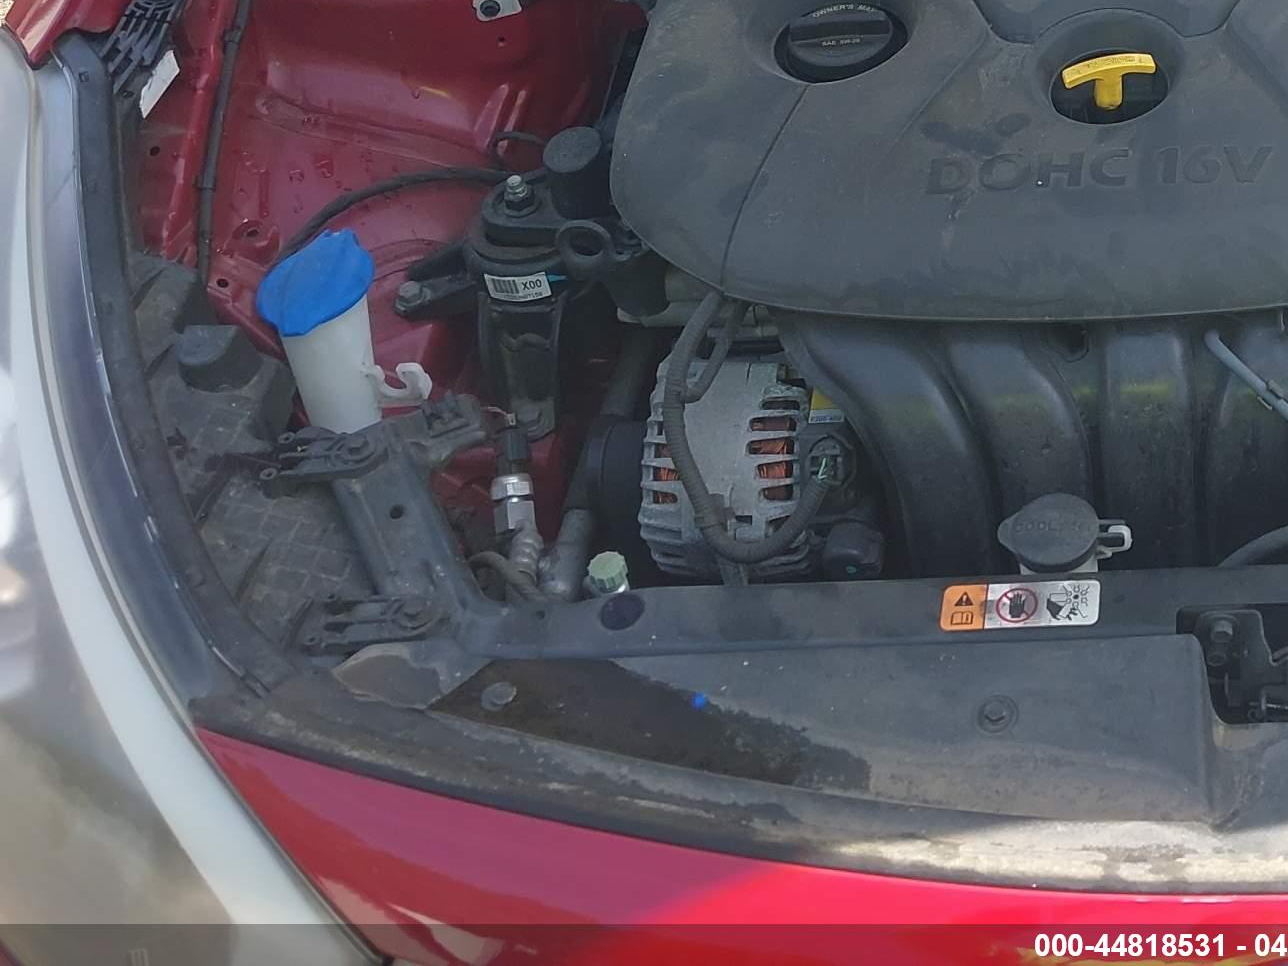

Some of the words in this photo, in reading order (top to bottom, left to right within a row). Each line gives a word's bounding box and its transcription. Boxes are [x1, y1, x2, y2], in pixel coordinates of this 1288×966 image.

[812, 4, 854, 18] OWNER'S
[927, 147, 1131, 194] DOHC
[1157, 145, 1272, 184] 16V
